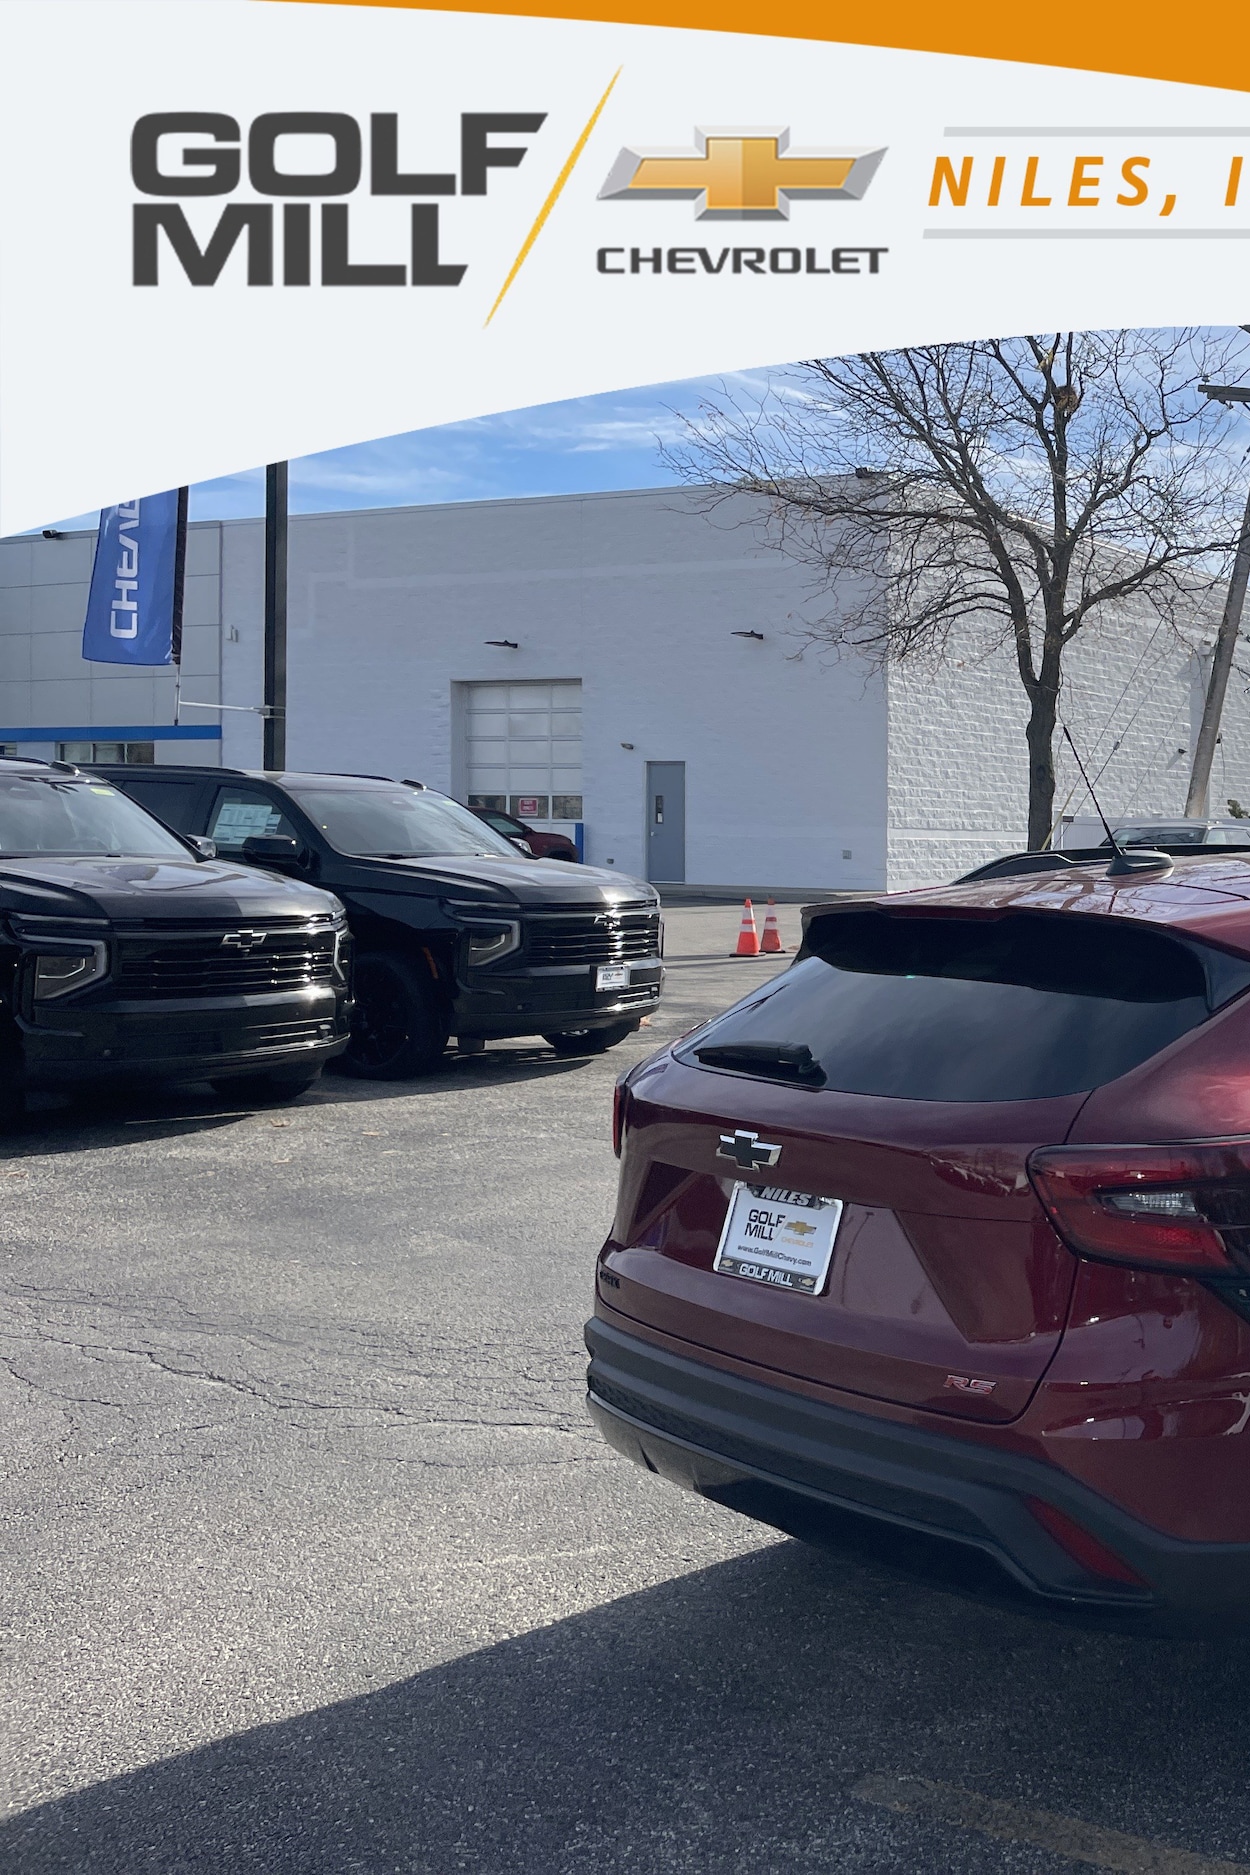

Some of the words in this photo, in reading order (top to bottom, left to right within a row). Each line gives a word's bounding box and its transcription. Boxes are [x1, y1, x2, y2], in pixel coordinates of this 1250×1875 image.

[760, 1186, 812, 1206] NILES
[748, 1209, 786, 1227] GOLF
[744, 1222, 774, 1241] MILL
[739, 1262, 769, 1280] GOLF
[767, 1270, 793, 1287] MILL
[943, 1374, 997, 1395] RS
